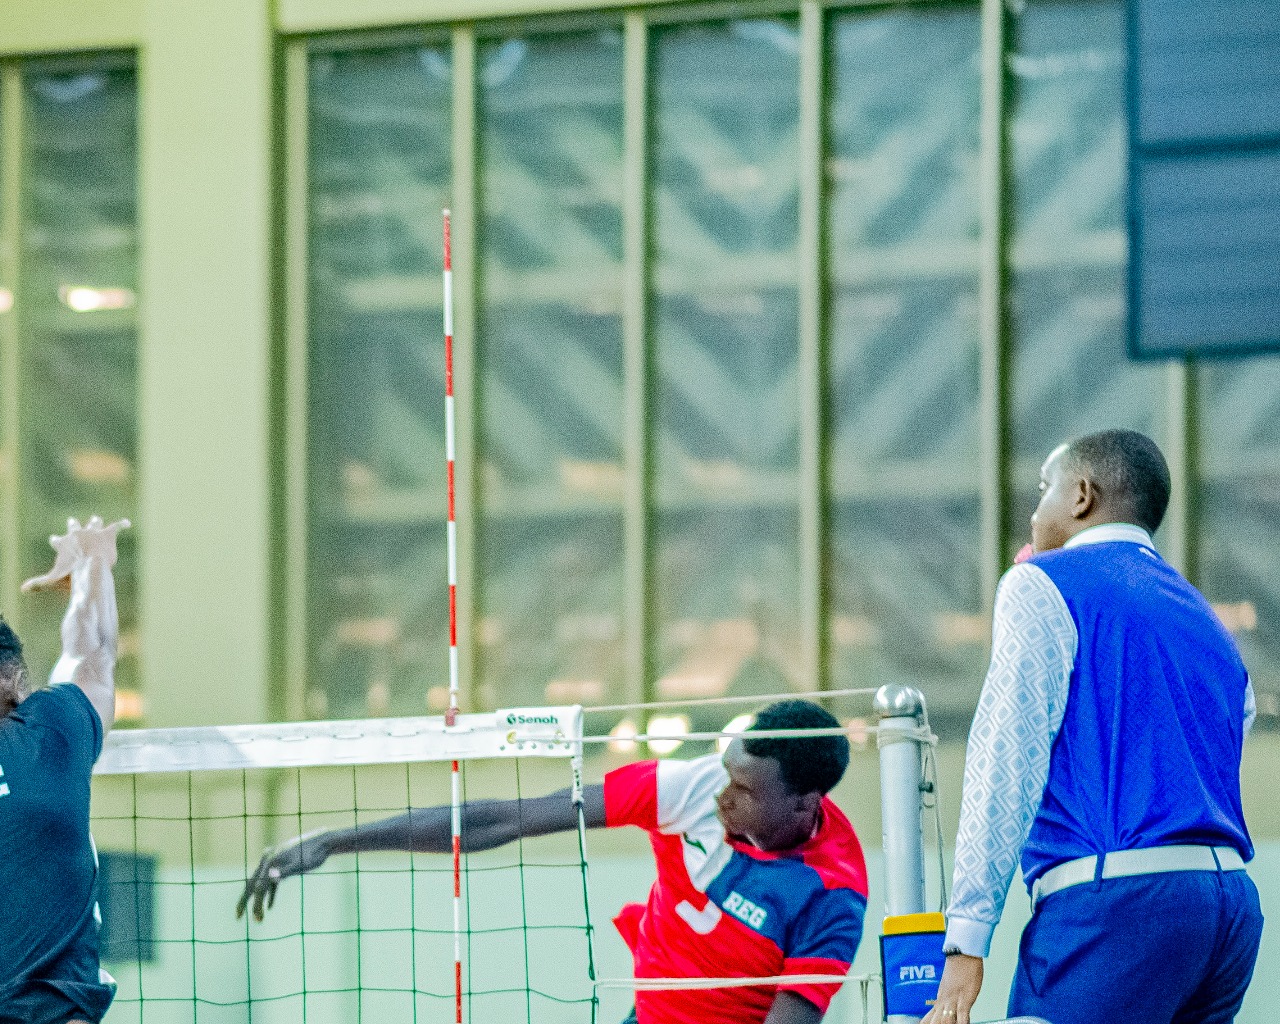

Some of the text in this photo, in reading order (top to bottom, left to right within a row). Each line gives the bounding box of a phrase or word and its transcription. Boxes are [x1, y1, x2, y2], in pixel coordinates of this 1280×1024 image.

[517, 715, 558, 724] Senoh
[721, 890, 768, 931] REG
[899, 964, 936, 981] FIVB
